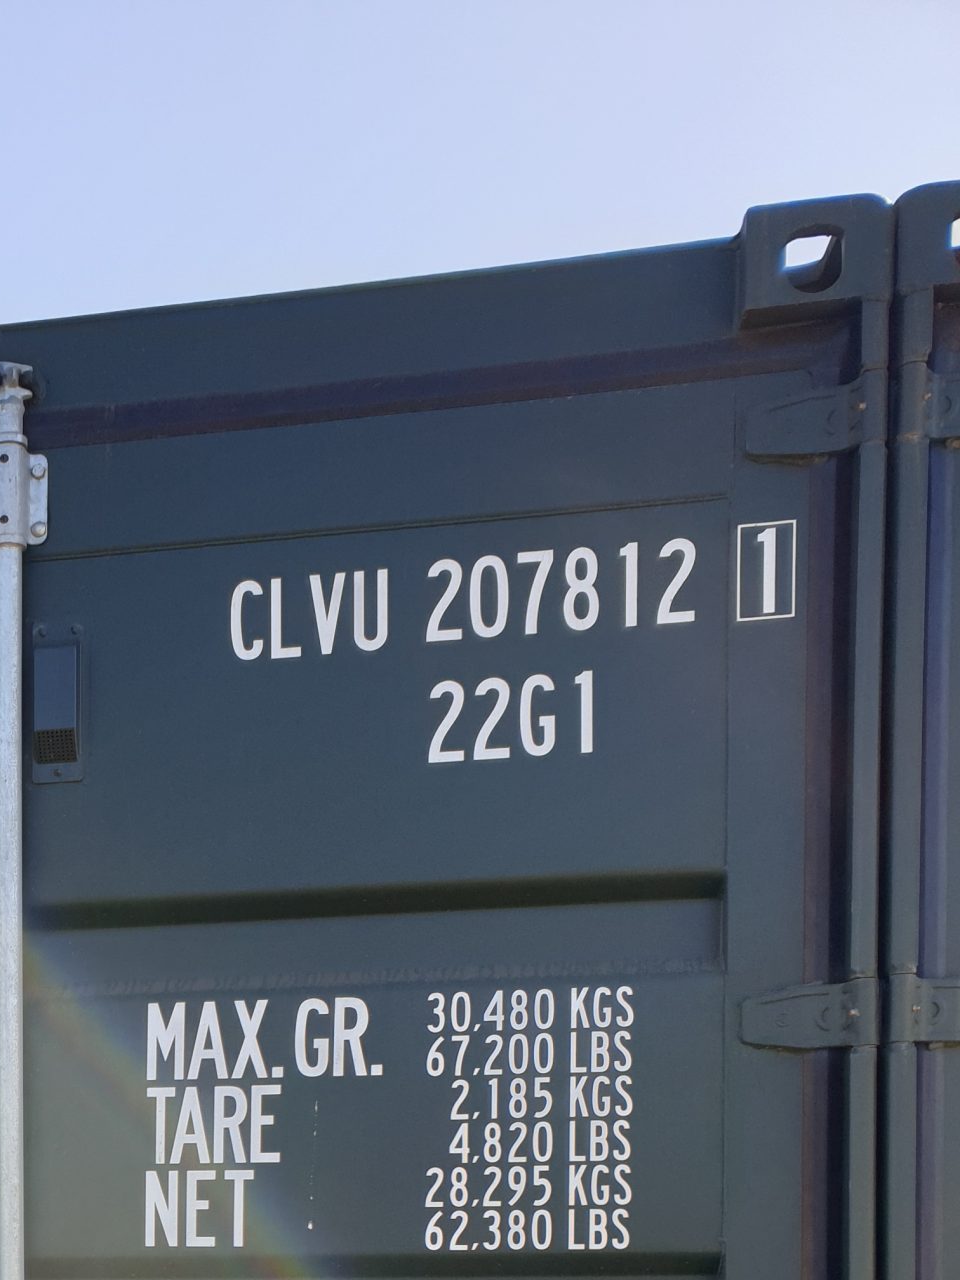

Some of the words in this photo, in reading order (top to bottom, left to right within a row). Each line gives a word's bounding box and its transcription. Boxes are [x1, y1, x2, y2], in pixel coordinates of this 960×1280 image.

[230, 568, 388, 661] CLVU
[425, 537, 696, 643] 207812
[756, 527, 777, 614] 1
[428, 670, 594, 764] 22G1
[426, 988, 555, 1034] 30,480
[570, 985, 635, 1029] KGS
[426, 1032, 554, 1077] 67,200
[569, 1030, 632, 1074] LBS
[146, 1084, 282, 1165] TARE
[450, 1076, 553, 1121] 2,185
[569, 1074, 633, 1118] KGS
[448, 1121, 553, 1164] 4,820
[568, 1119, 631, 1162] LBS
[144, 1169, 255, 1248] NET
[424, 1164, 552, 1208] 28,295
[568, 1163, 632, 1206] KGS
[424, 1209, 553, 1251] 62,380
[567, 1208, 630, 1250] LBS
